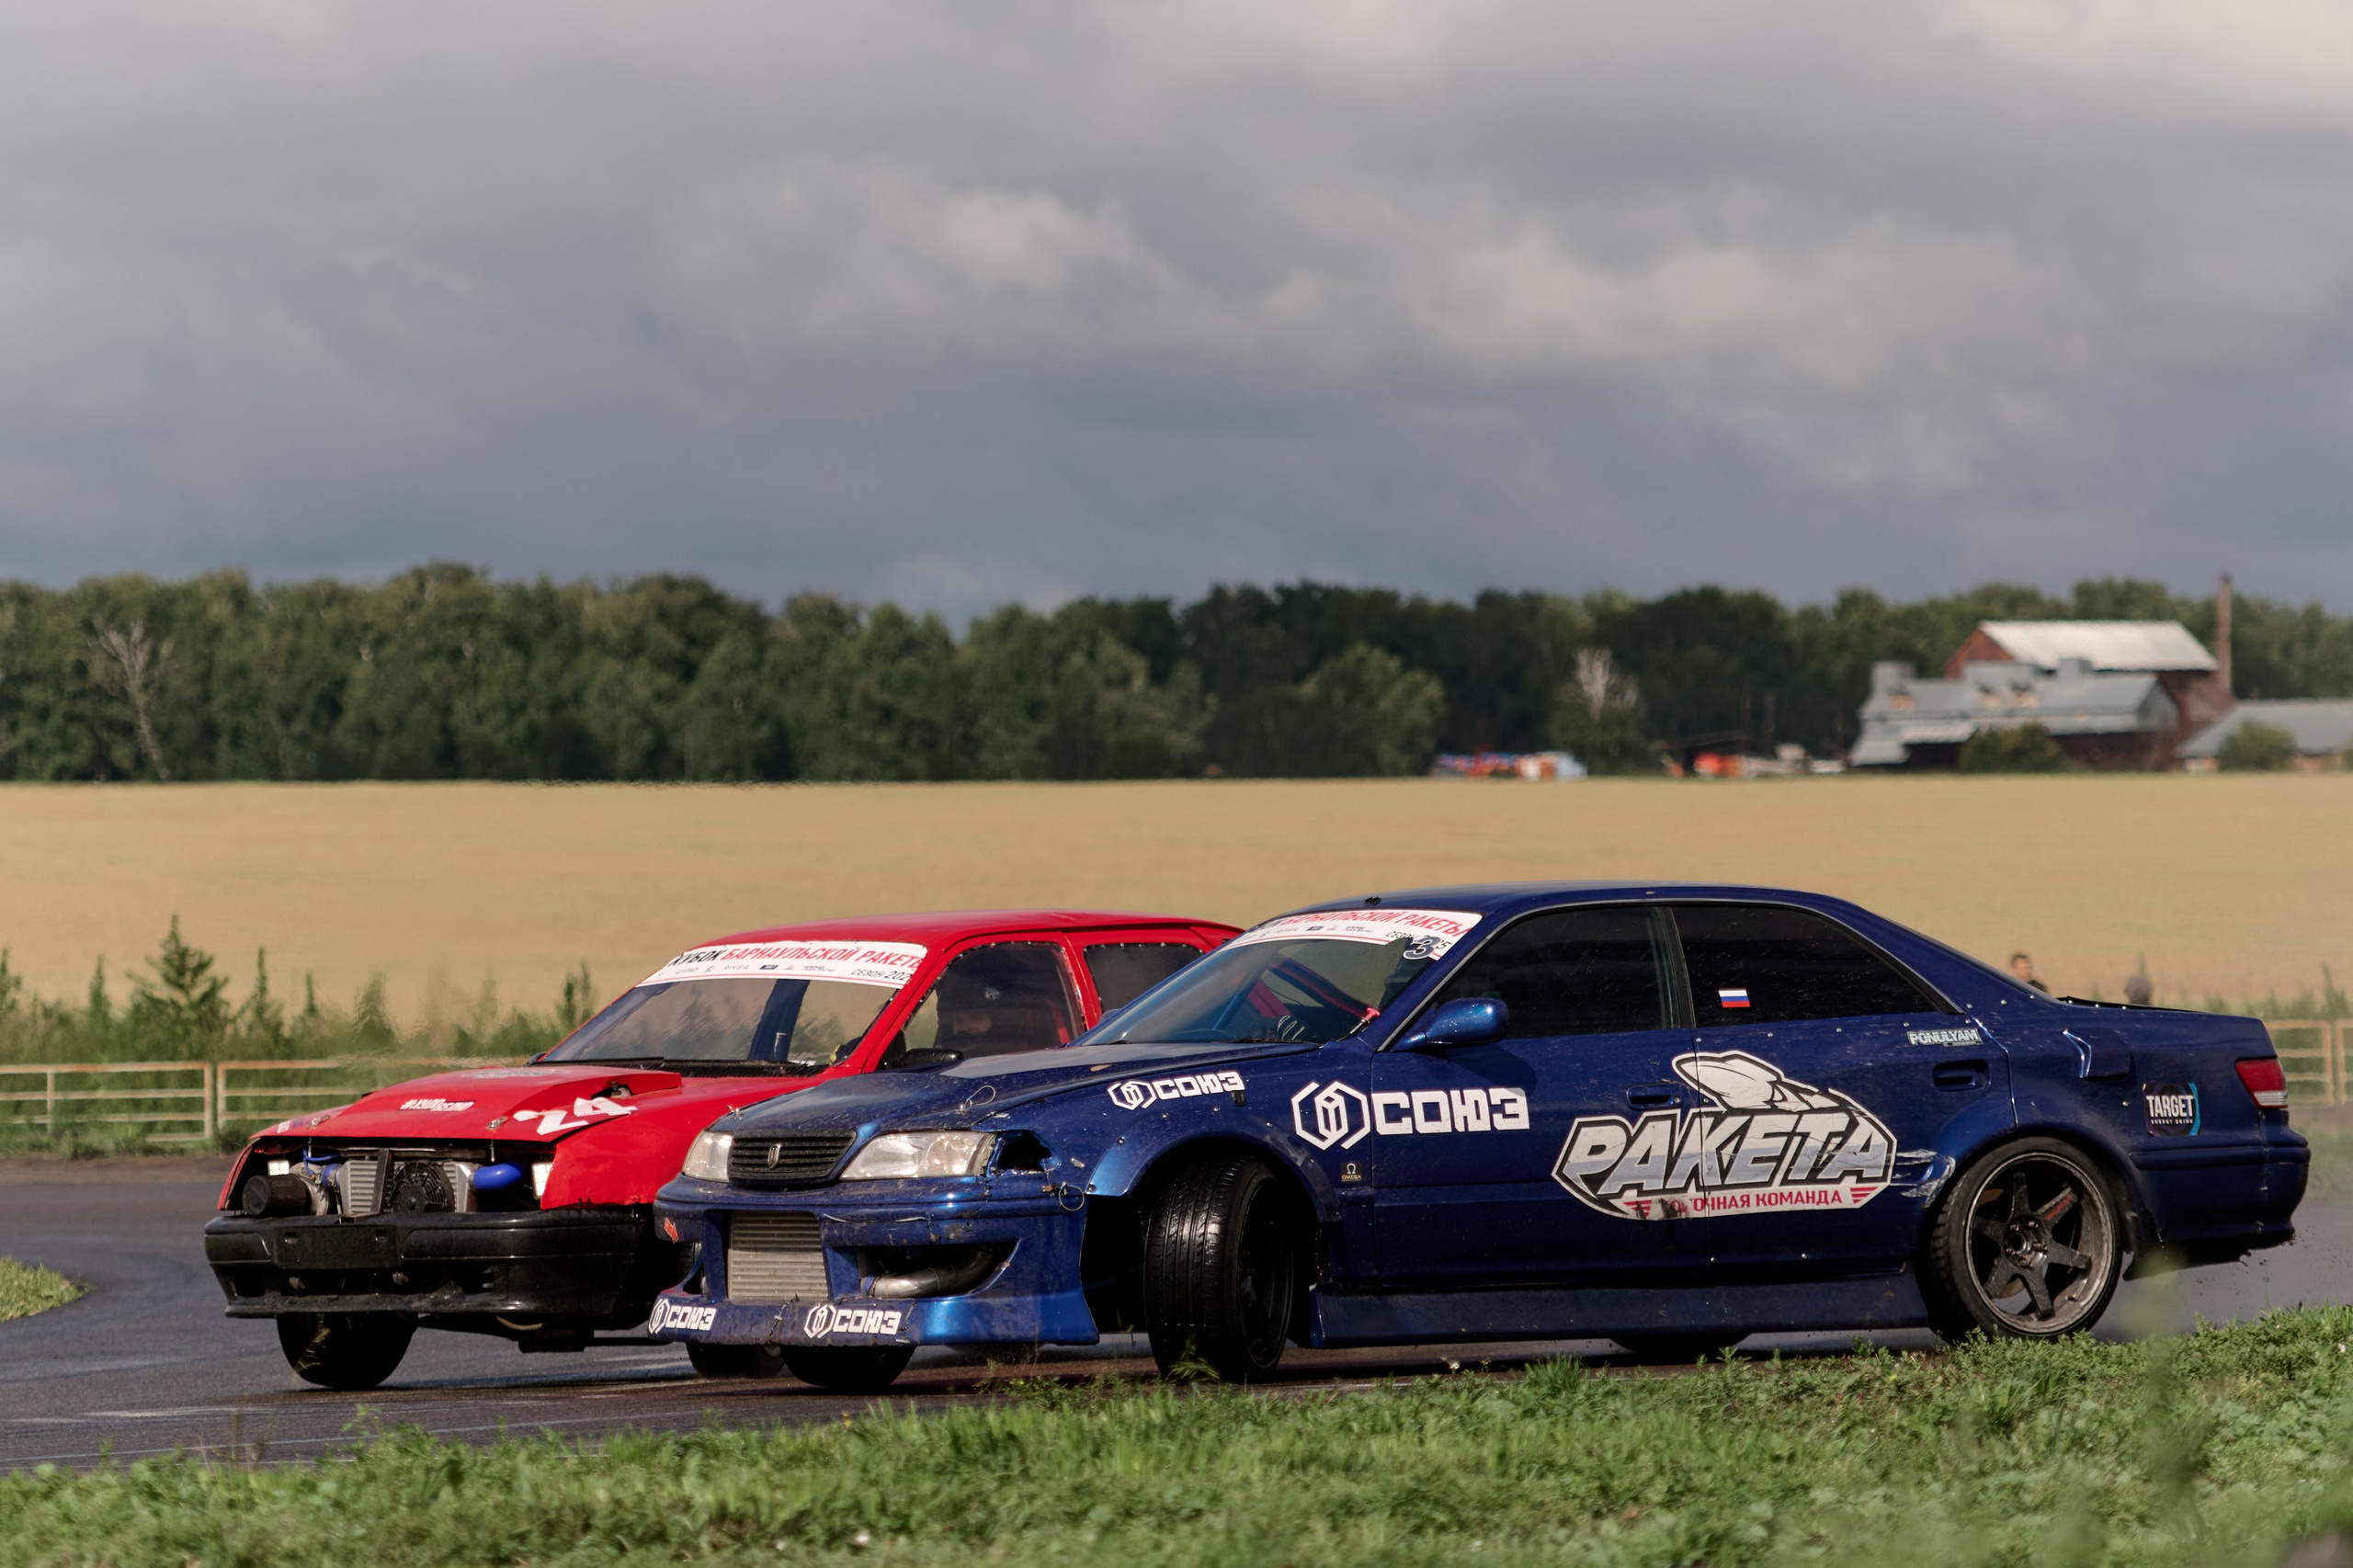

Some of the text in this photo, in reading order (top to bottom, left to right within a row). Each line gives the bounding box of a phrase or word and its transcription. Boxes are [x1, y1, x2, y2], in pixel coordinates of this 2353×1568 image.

[720, 946, 860, 961] БАРНАУЛЬСКОЙ
[1403, 936, 1441, 960] 3
[850, 969, 913, 982] СЕЗОН 202
[1908, 1028, 1980, 1045] PONULYAM
[1156, 1071, 1246, 1100] СОЮЗ
[1370, 1087, 1530, 1136] СОЮЗ
[2145, 1095, 2195, 1118] TARGET
[1661, 1189, 1843, 1214] ООЧНАЯ КОМАНДА
[665, 1305, 717, 1332] СОЮЗ
[833, 1308, 903, 1335] СОЮЗ
